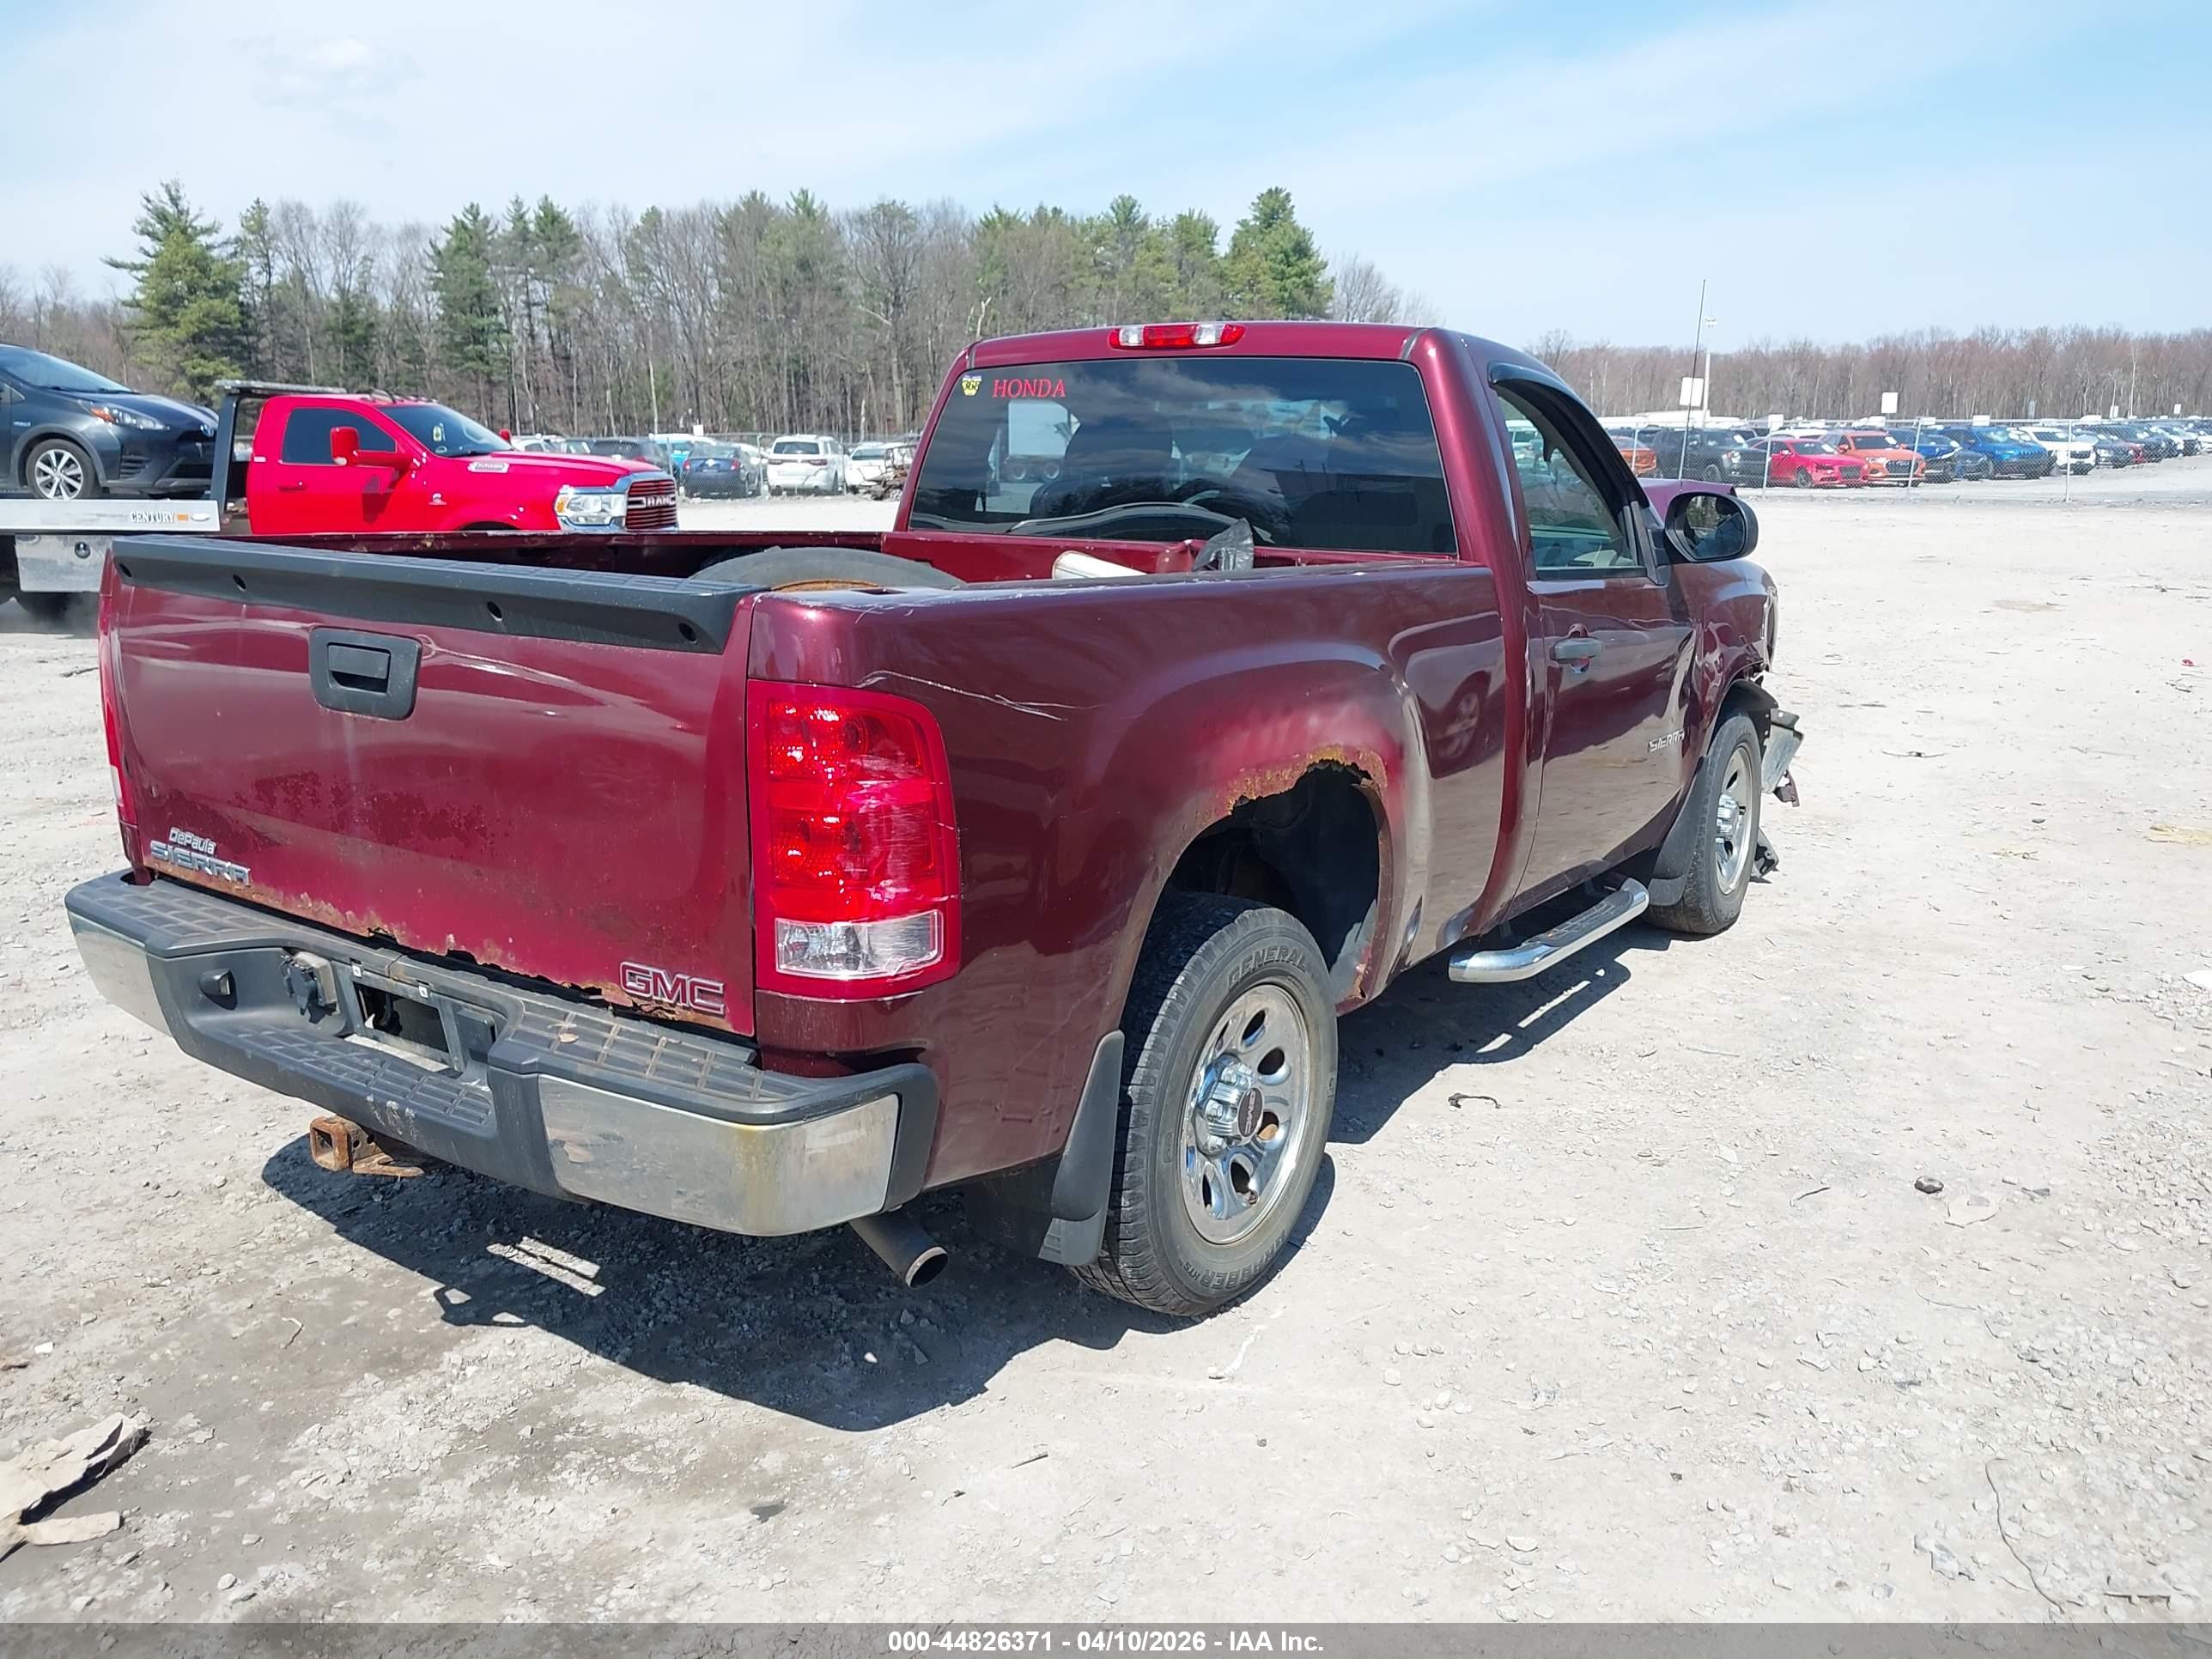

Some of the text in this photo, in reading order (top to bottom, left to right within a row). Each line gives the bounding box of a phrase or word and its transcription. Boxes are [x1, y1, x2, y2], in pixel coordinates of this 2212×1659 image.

[992, 378, 1067, 399] HONDA
[130, 511, 175, 523] CENTURY
[1649, 729, 1685, 753] SIERRA
[168, 827, 216, 855] DePaula
[150, 840, 252, 888] SIERRA
[1227, 945, 1306, 992] GENERAL
[620, 961, 725, 1016] GMC
[1244, 1089, 1256, 1134] GMC
